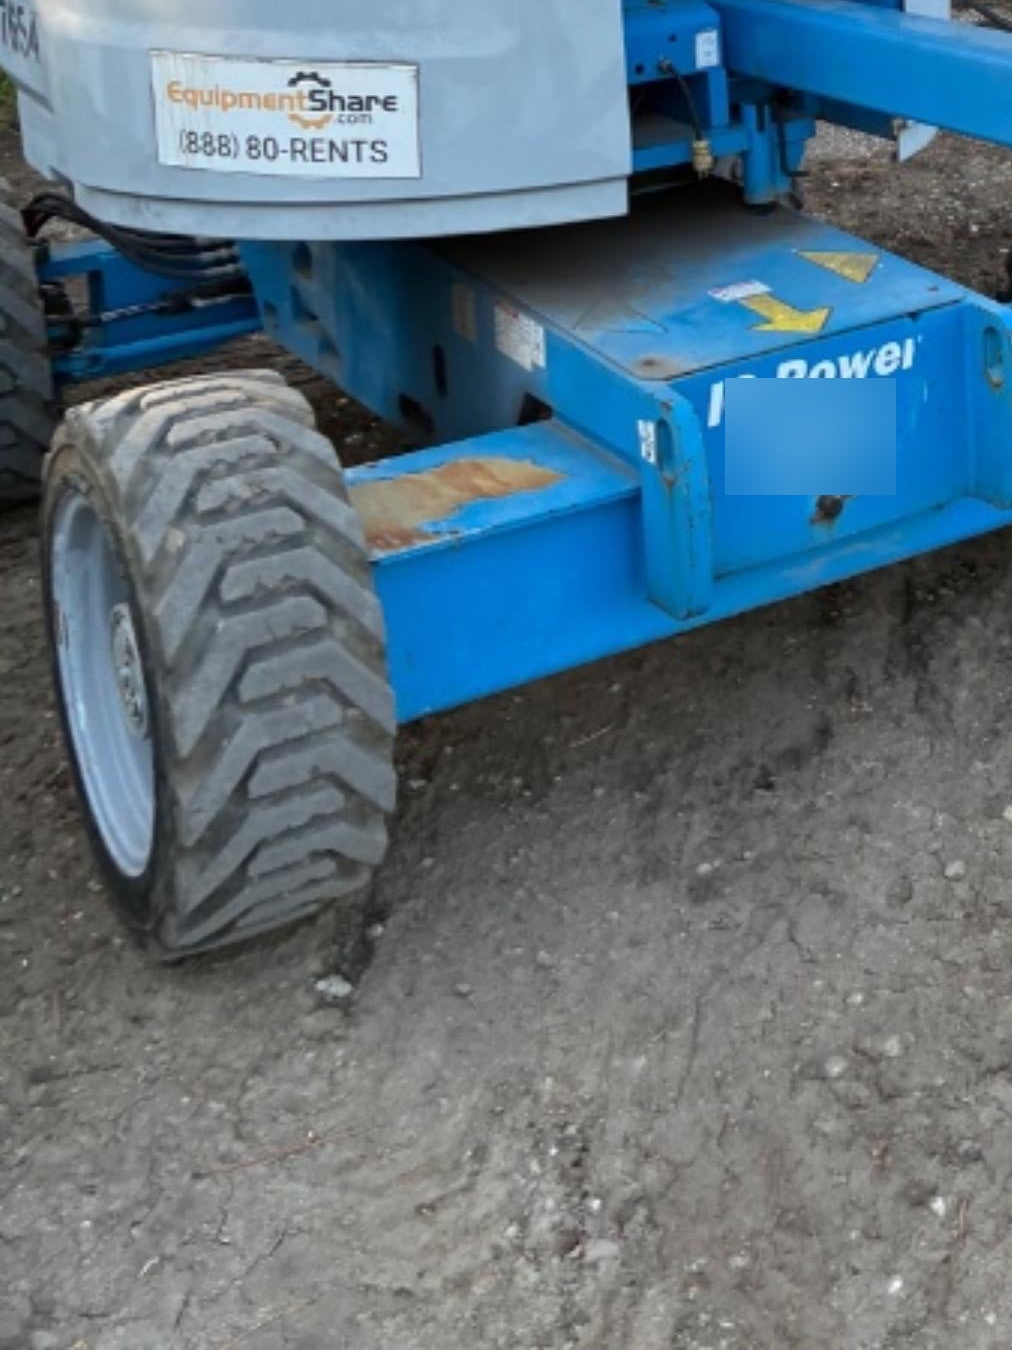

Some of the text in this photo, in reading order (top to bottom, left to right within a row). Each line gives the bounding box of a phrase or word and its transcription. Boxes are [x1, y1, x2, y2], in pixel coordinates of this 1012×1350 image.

[166, 80, 398, 113] EquipmentShare
[179, 129, 388, 164] (888) 80-RENTS
